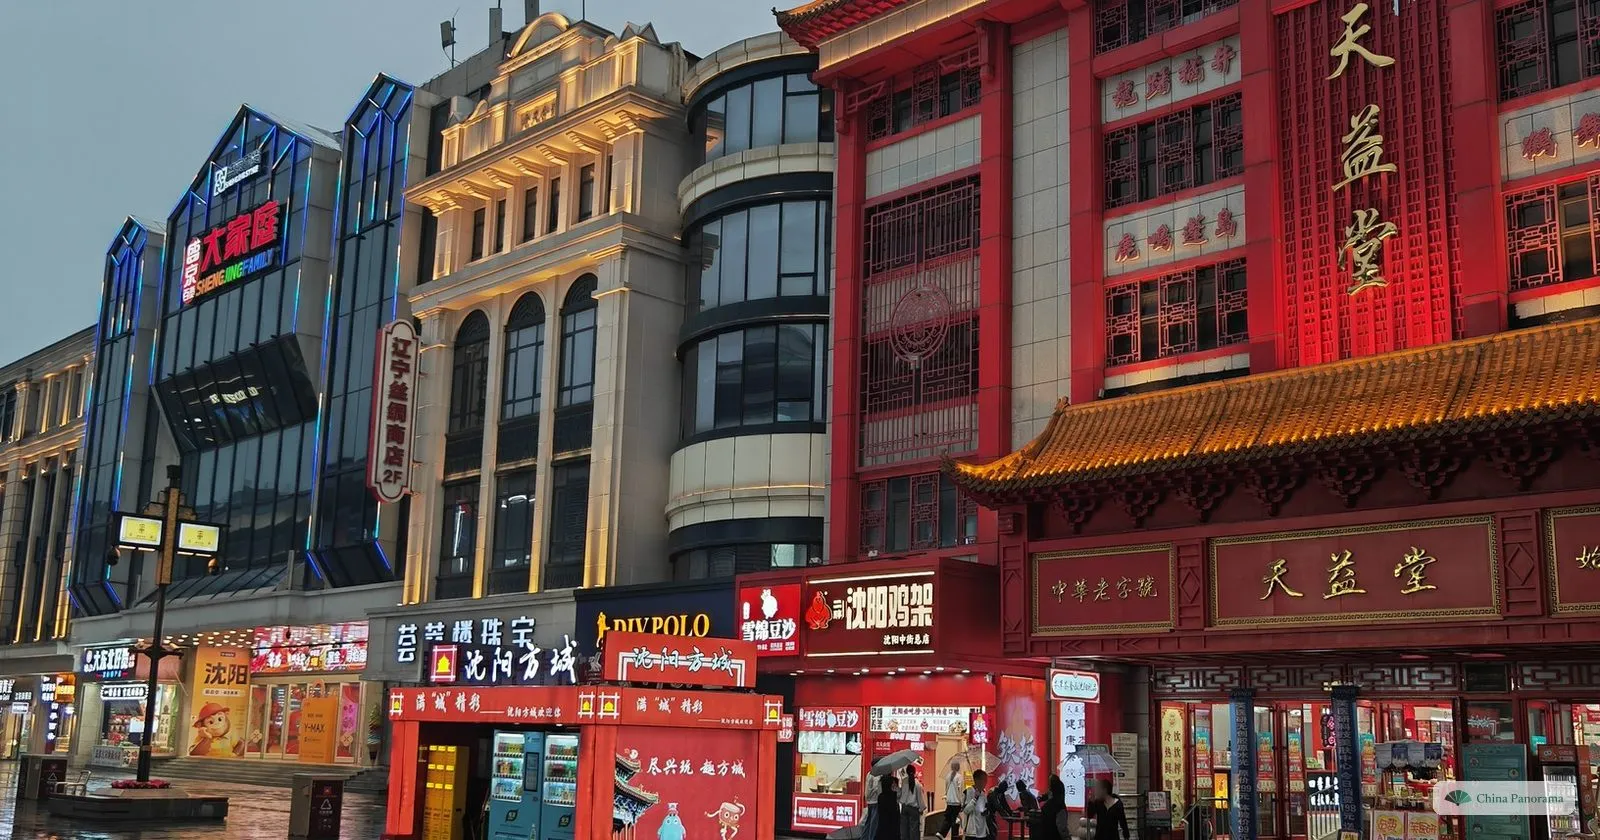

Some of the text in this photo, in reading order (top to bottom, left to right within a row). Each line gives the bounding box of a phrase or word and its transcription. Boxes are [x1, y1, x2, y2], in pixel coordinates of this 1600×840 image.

[1325, 3, 1397, 296] 天益堂
[202, 200, 279, 272] 大家庭
[383, 469, 403, 484] 2F
[1259, 546, 1438, 600] 天益堂
[1051, 575, 1158, 603] 中華老字號
[846, 583, 933, 630] 沈阳鸡架
[652, 613, 710, 637] POLO
[742, 618, 796, 641] 雪绵豆沙
[883, 634, 930, 645] 沈阳中街总店
[464, 634, 577, 684] 沈阳方城
[632, 646, 733, 677] 沈阳方城
[204, 662, 248, 685] 沈阳
[304, 723, 325, 733] Y-MAX
[647, 757, 746, 778] 尽兴玩 趣方城
